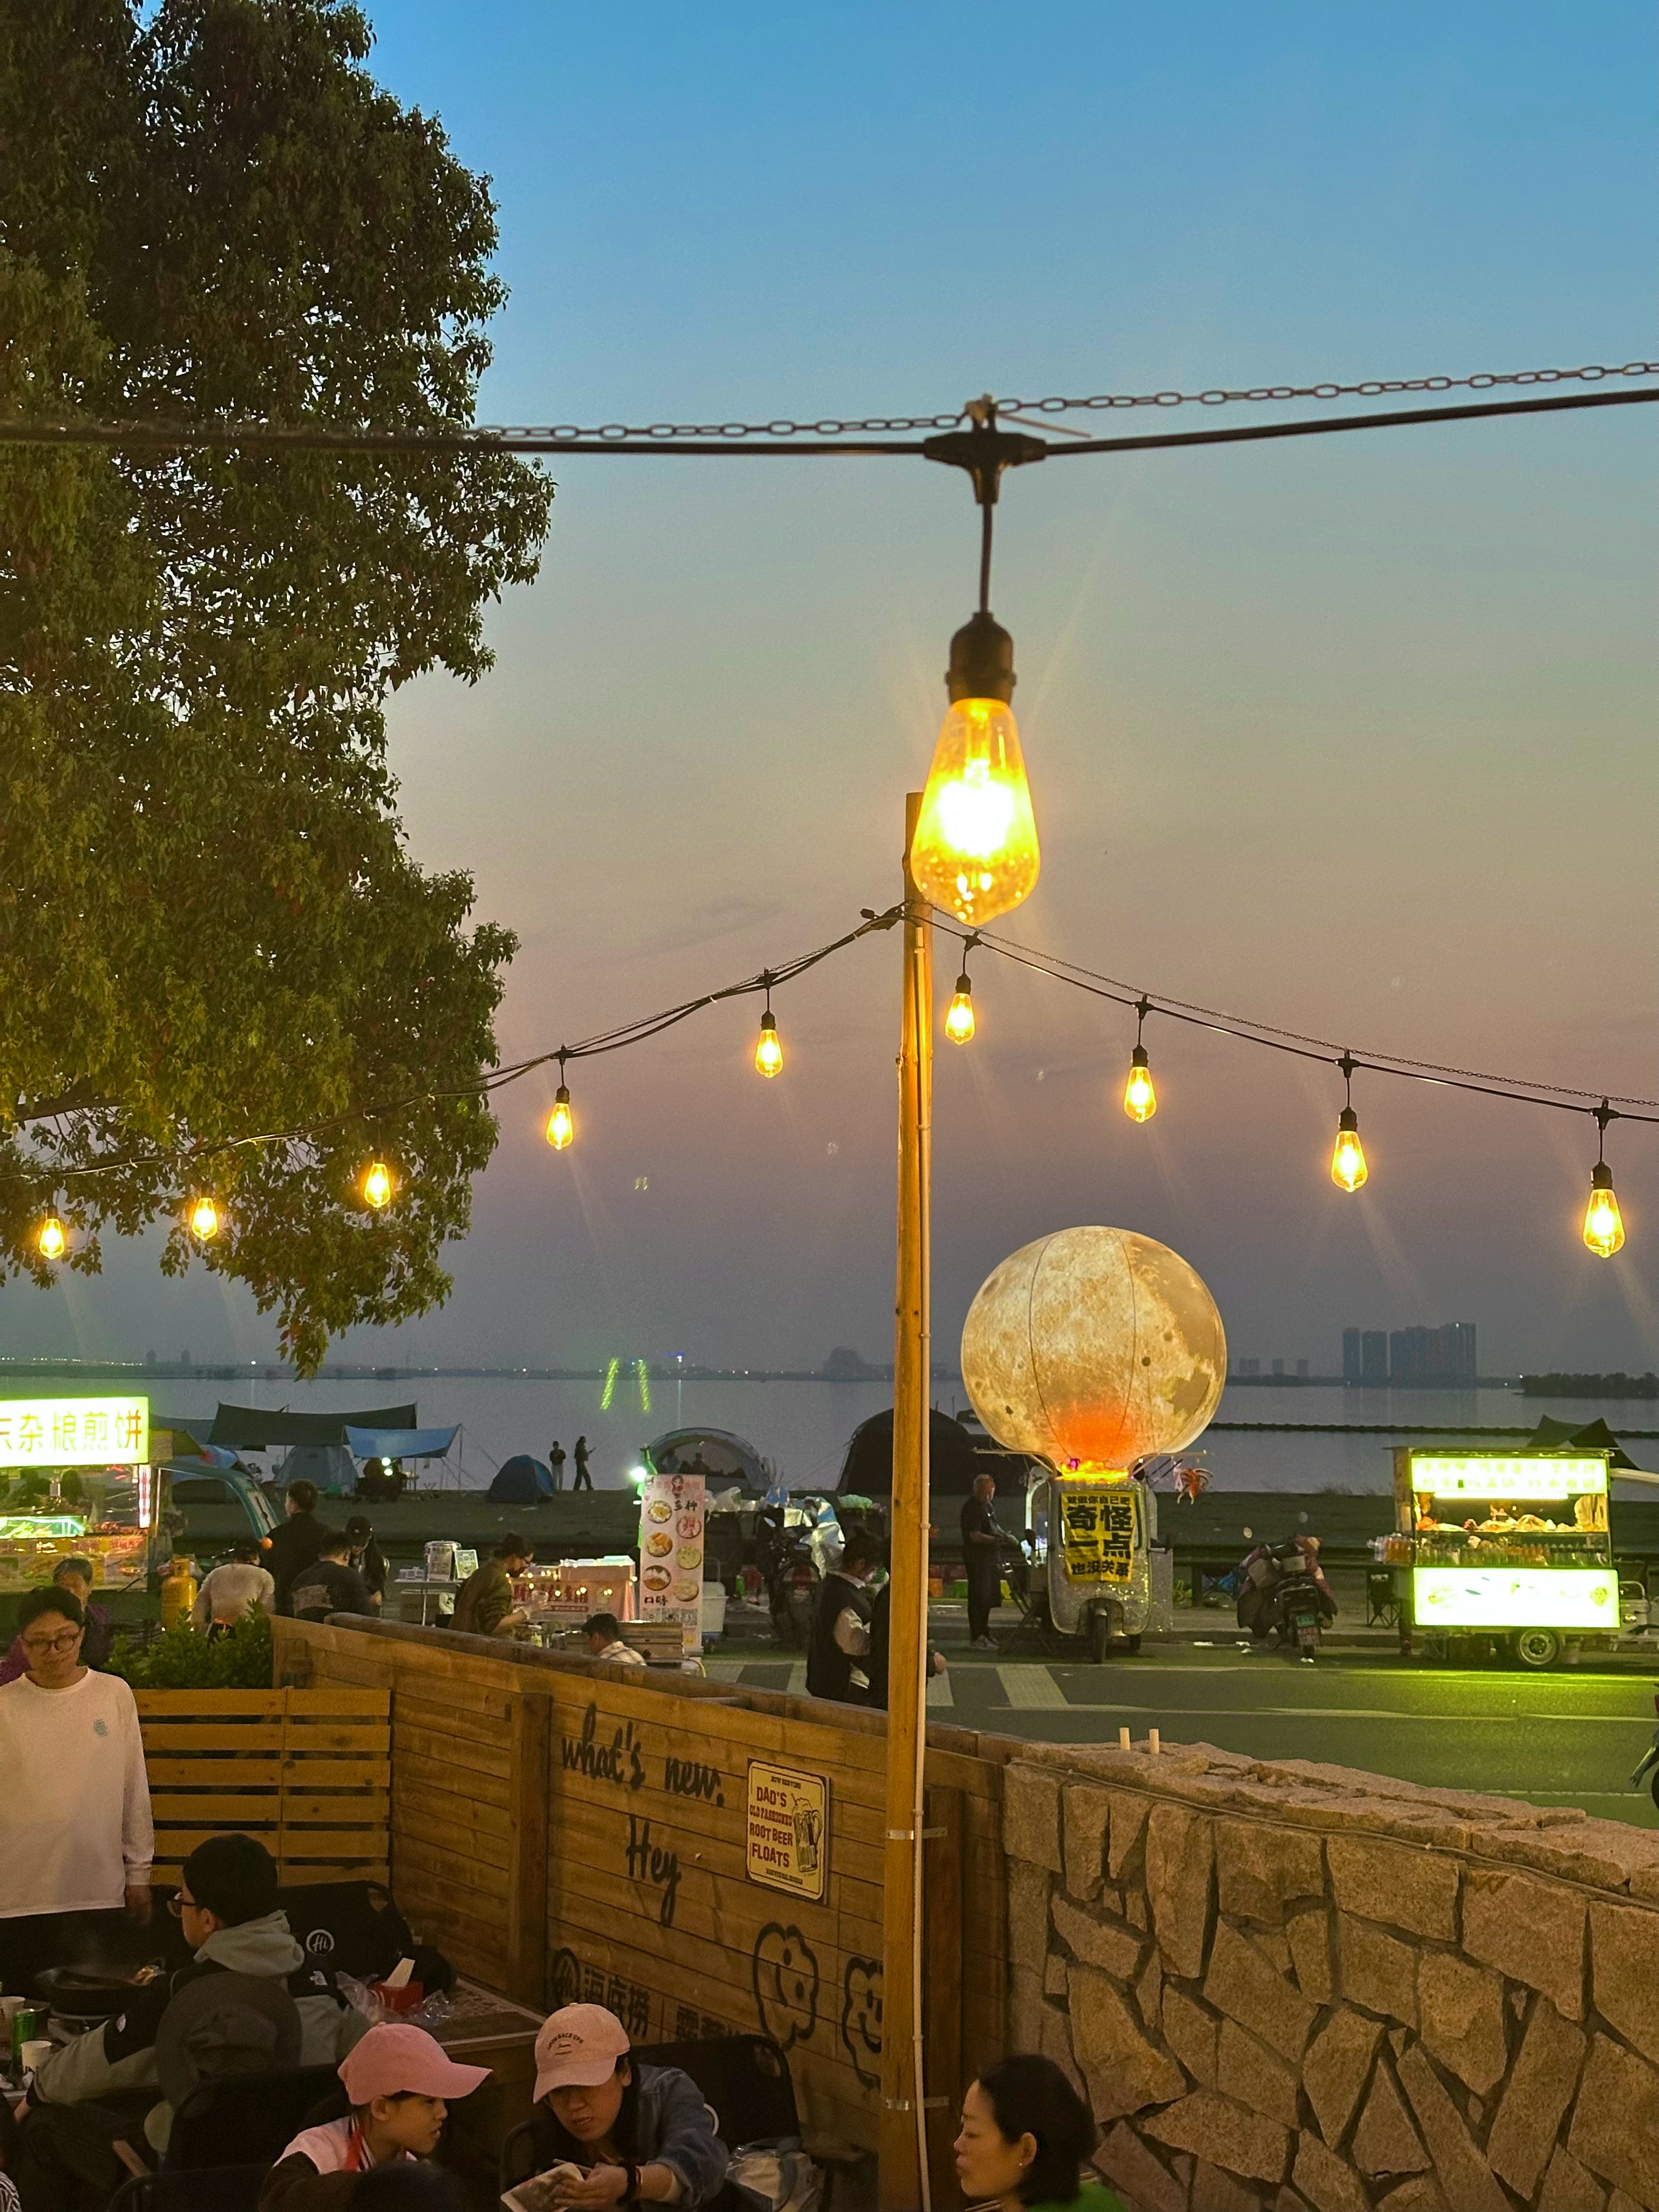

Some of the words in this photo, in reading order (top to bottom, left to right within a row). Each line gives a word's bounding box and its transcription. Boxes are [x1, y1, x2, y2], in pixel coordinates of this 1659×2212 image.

[1067, 1505, 1132, 1531] 奇怪
[1069, 1532, 1131, 1559] 一点
[1071, 1560, 1130, 1576] 也没关系
[644, 1595, 668, 1607] 口味
[757, 1786, 787, 1807] DAD'S
[749, 1822, 771, 1842] ROOT
[772, 1827, 793, 1847] BEER
[752, 1842, 789, 1867] FLOATS
[625, 1815, 682, 1927] Hey
